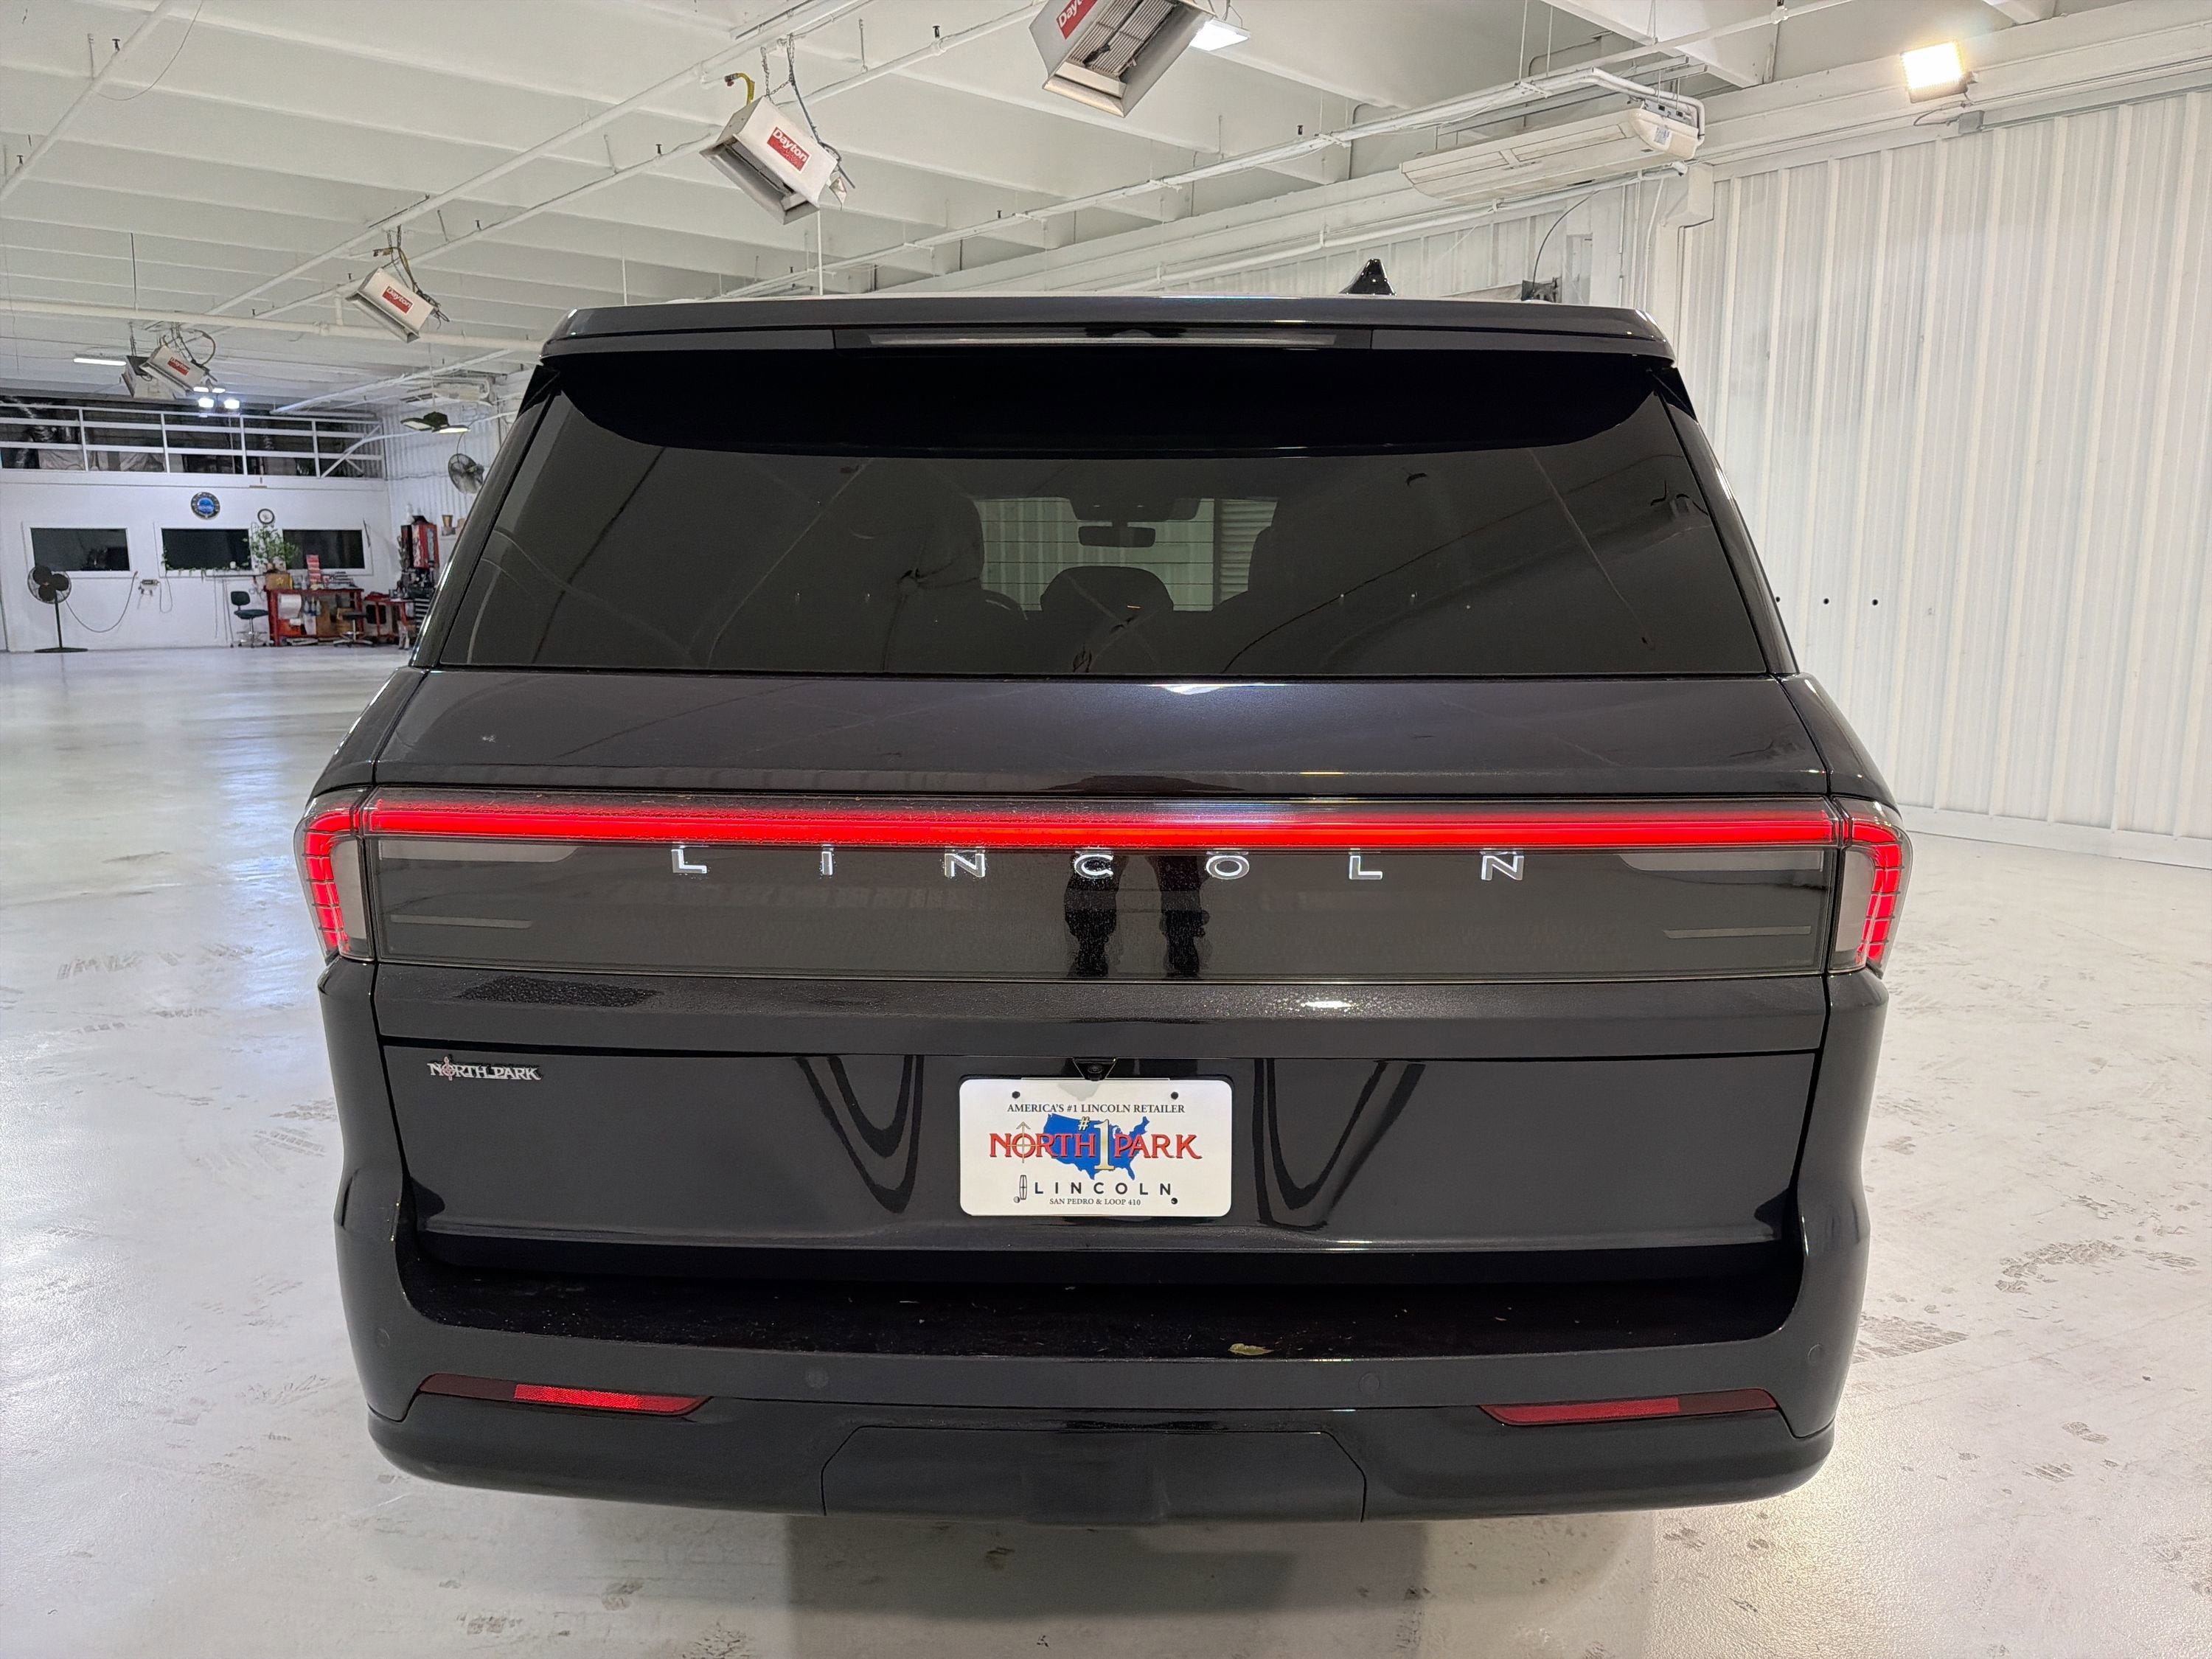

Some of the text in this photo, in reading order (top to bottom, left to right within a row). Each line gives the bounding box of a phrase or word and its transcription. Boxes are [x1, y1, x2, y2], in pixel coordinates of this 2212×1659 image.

[772, 129, 807, 162] Dayton
[386, 288, 411, 308] Dayton
[671, 848, 1525, 882] LINCOLN
[427, 1060, 542, 1081] NORTH PARK
[1007, 1103, 1185, 1113] AMERICA'S #1 LINCOLN RETAILER
[989, 1132, 1203, 1160] NORTH PARK
[1034, 1181, 1171, 1196] LINCOLN
